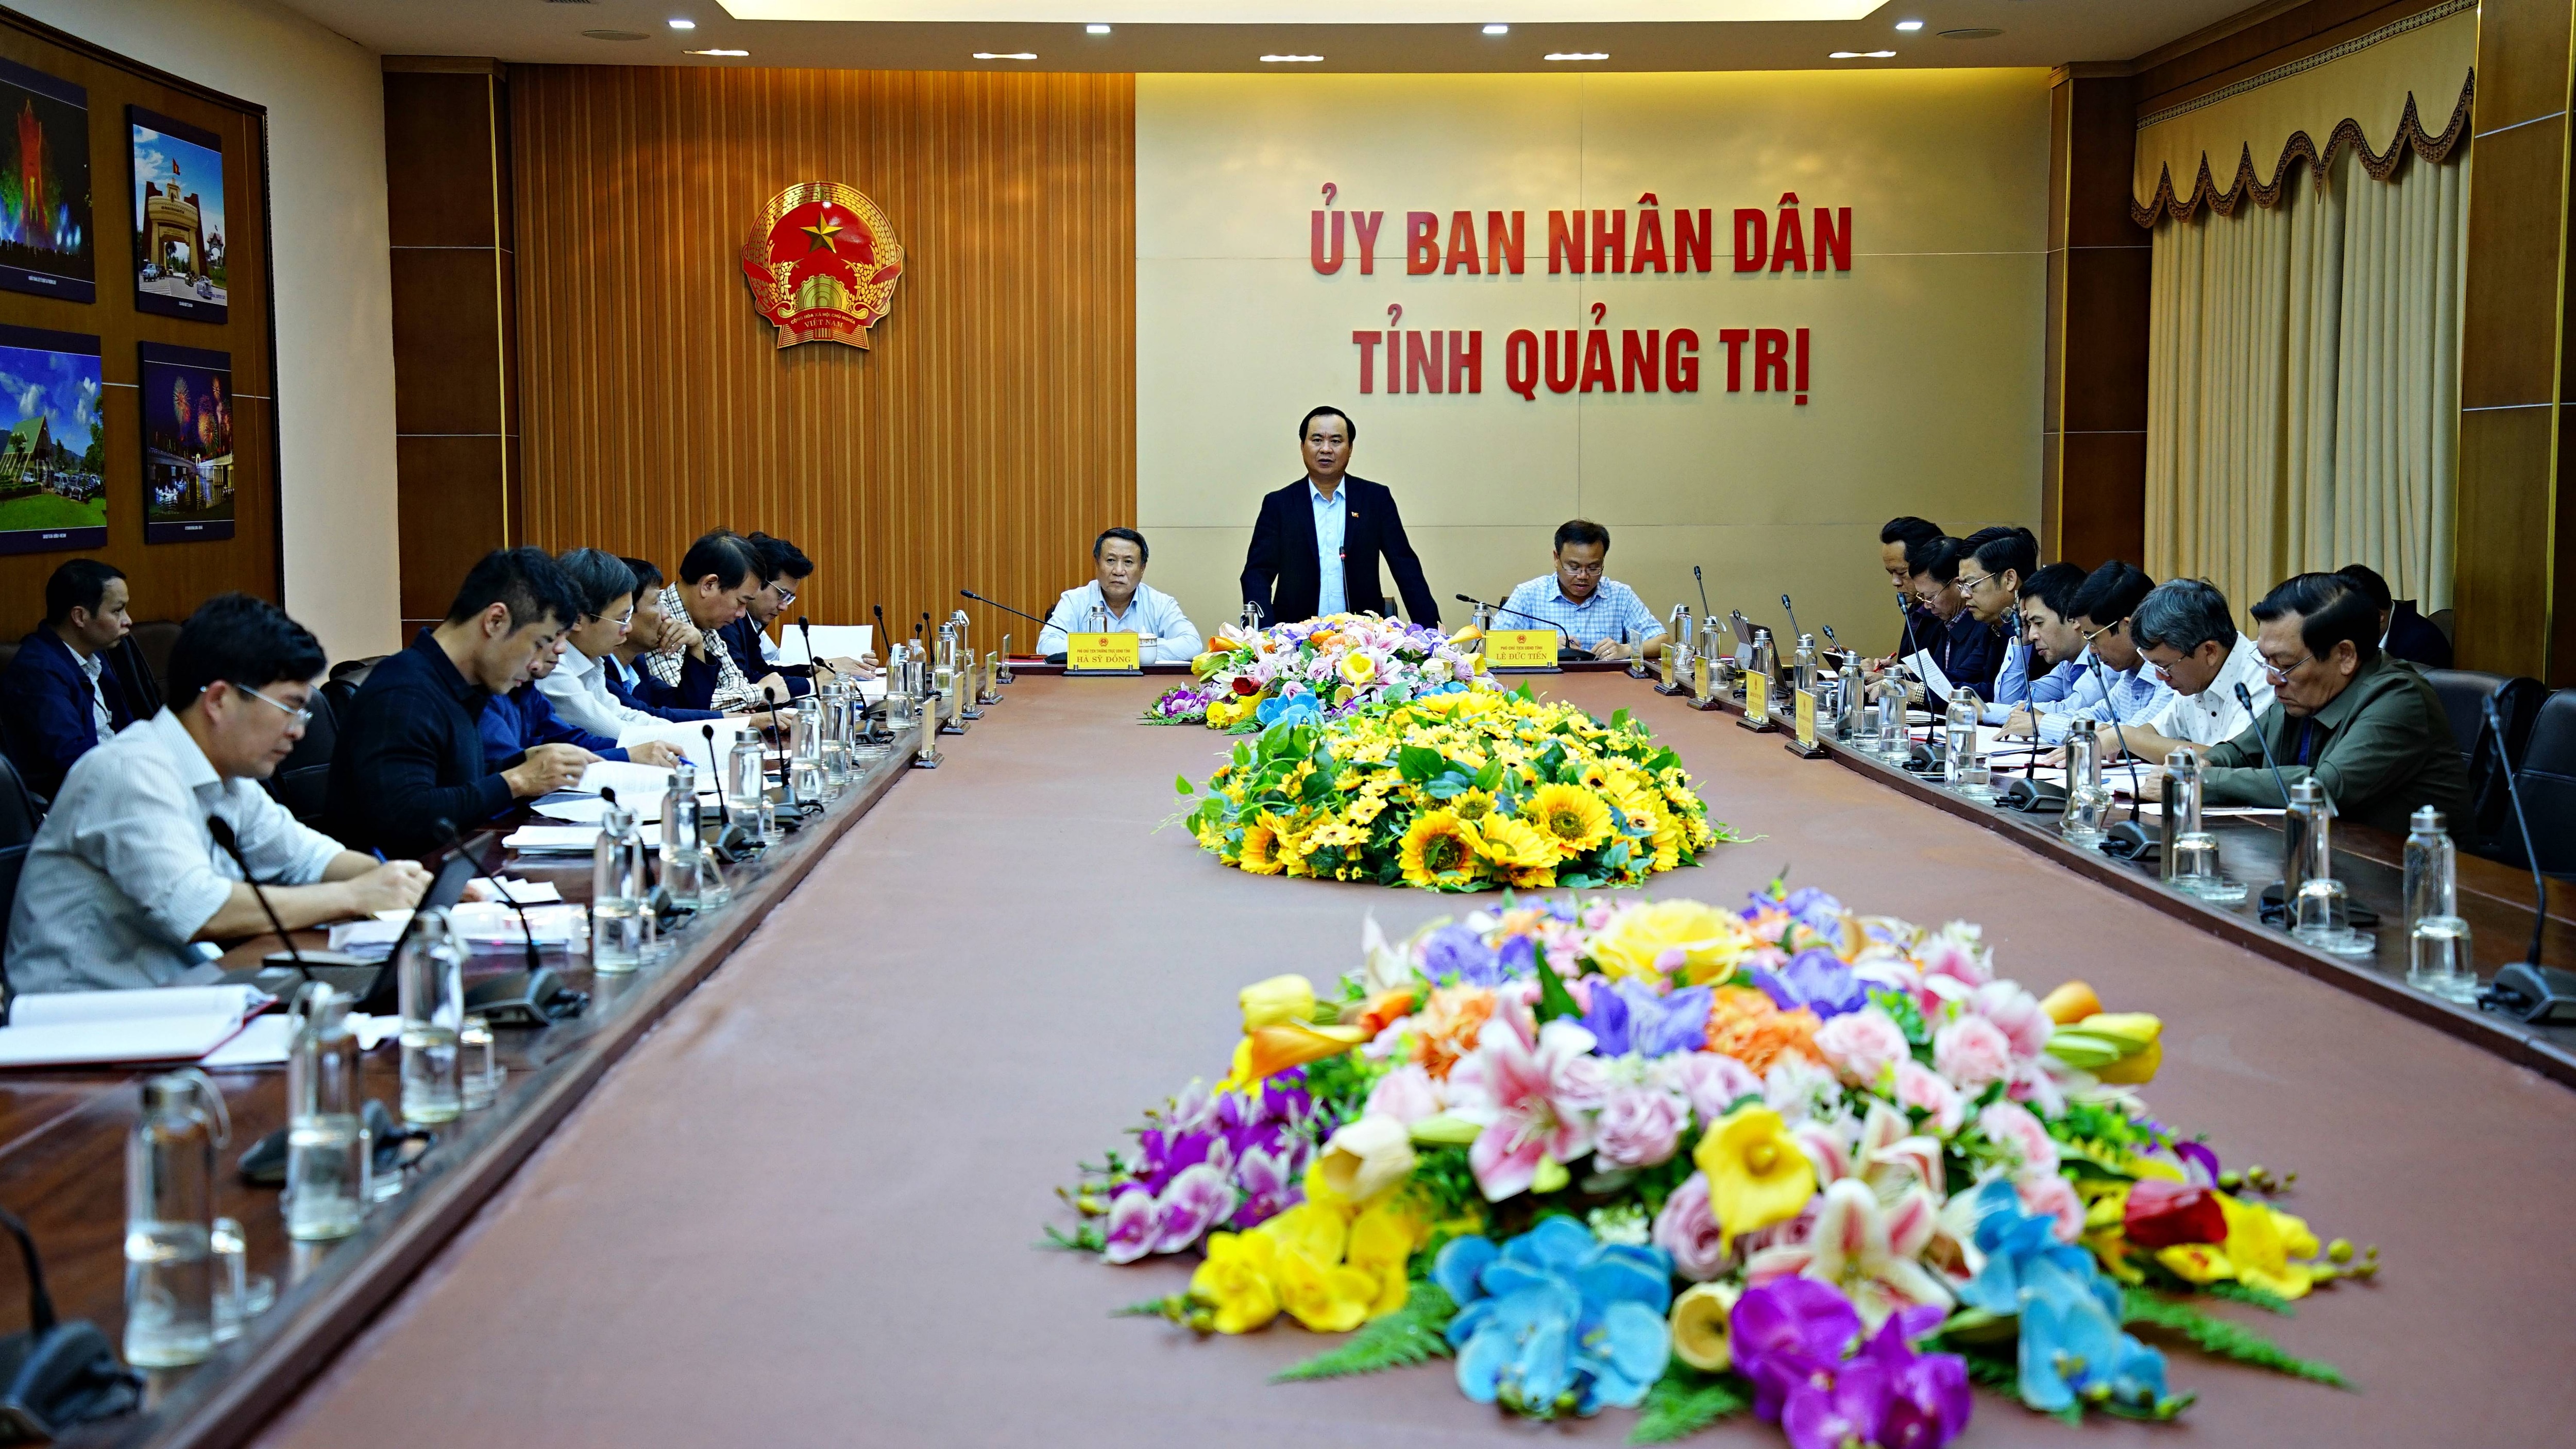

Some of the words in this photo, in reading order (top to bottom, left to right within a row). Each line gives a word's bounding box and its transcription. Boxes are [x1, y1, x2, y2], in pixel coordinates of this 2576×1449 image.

[1311, 182, 1383, 275] ỦY
[1407, 210, 1525, 275] BAN
[1548, 192, 1713, 274] NHÂN
[1734, 191, 1852, 272] DÂN
[804, 318, 823, 328] VIỆT
[825, 319, 843, 328] NAM
[841, 316, 856, 325] NGHĨA
[1352, 303, 1482, 394] TỈNH
[1505, 302, 1699, 401] QUẢNG
[1719, 328, 1810, 405] TRỊ
[1106, 653, 1131, 662] ĐỒNG
[1528, 651, 1547, 659] TIẾN
